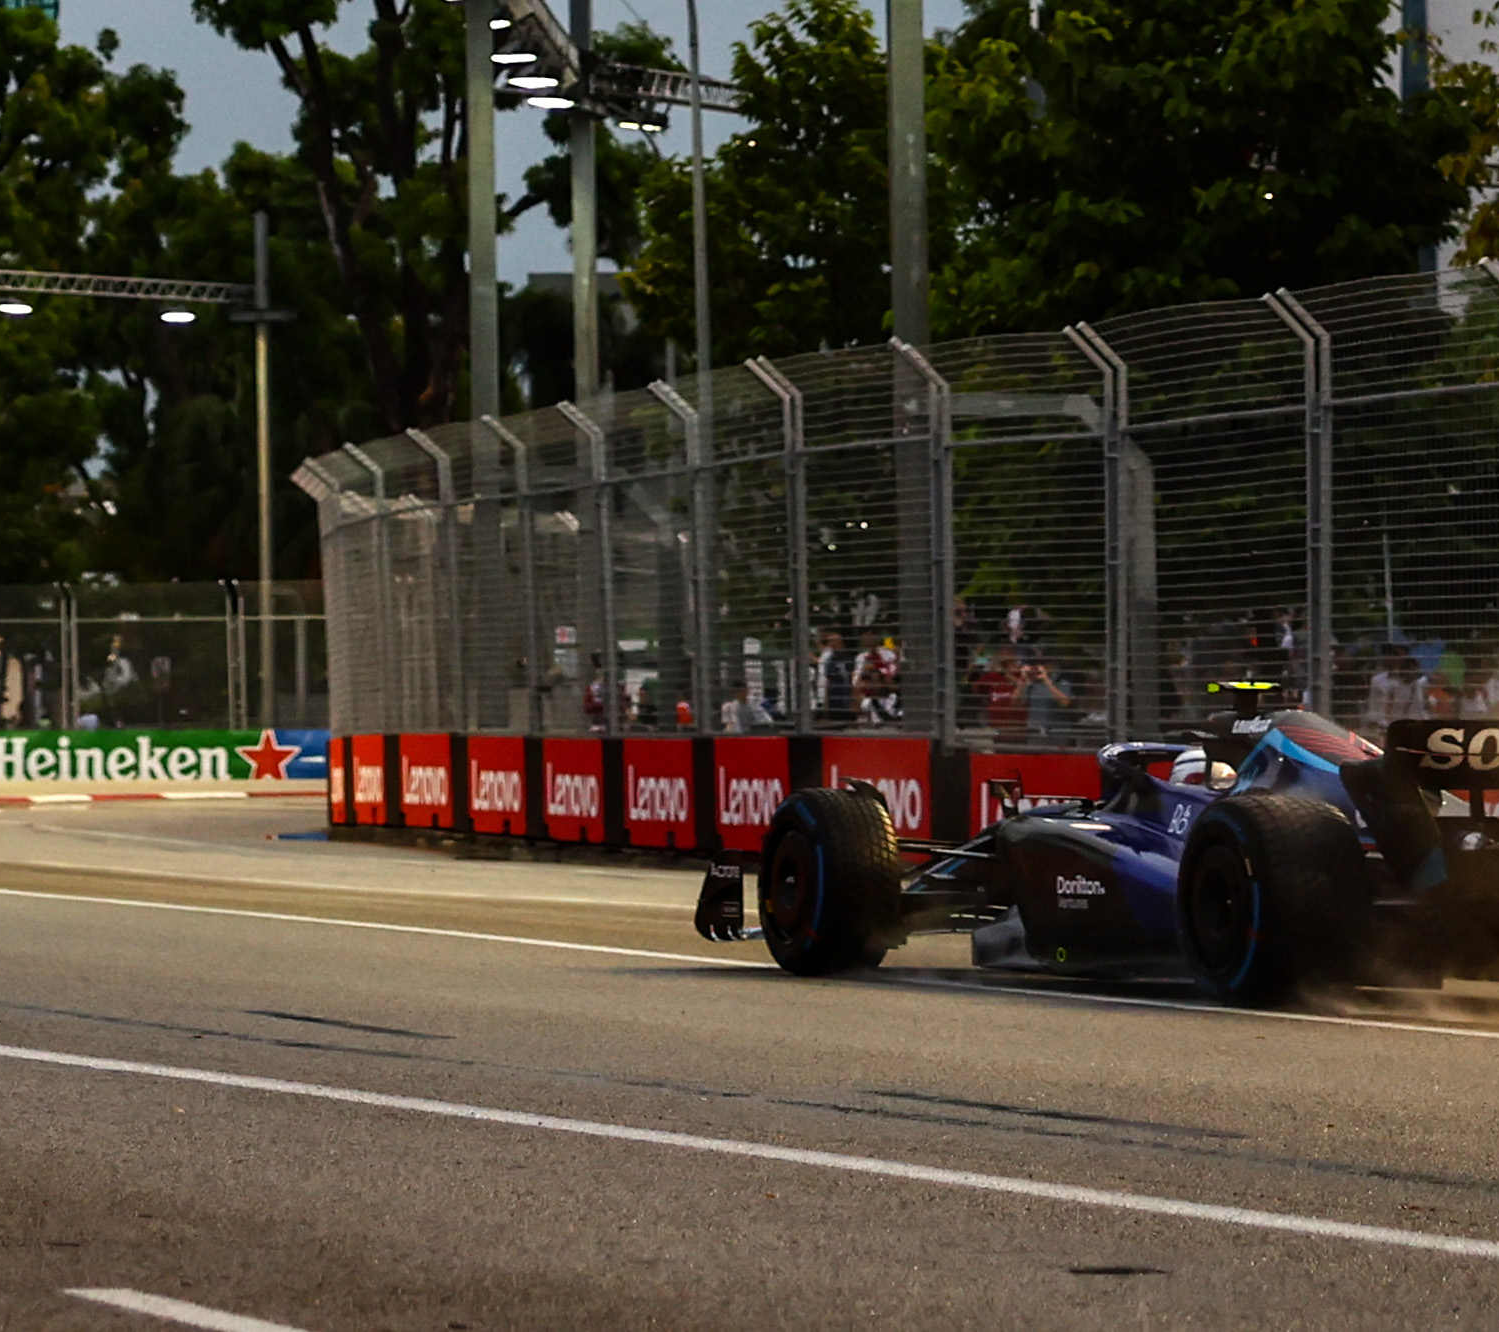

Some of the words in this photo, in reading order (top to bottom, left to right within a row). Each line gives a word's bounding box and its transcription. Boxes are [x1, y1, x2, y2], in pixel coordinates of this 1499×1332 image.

[471, 759, 522, 812] Lenovo
[546, 762, 599, 818] Lenovo
[628, 765, 688, 822] Lenovo
[719, 766, 784, 826] Lenovo
